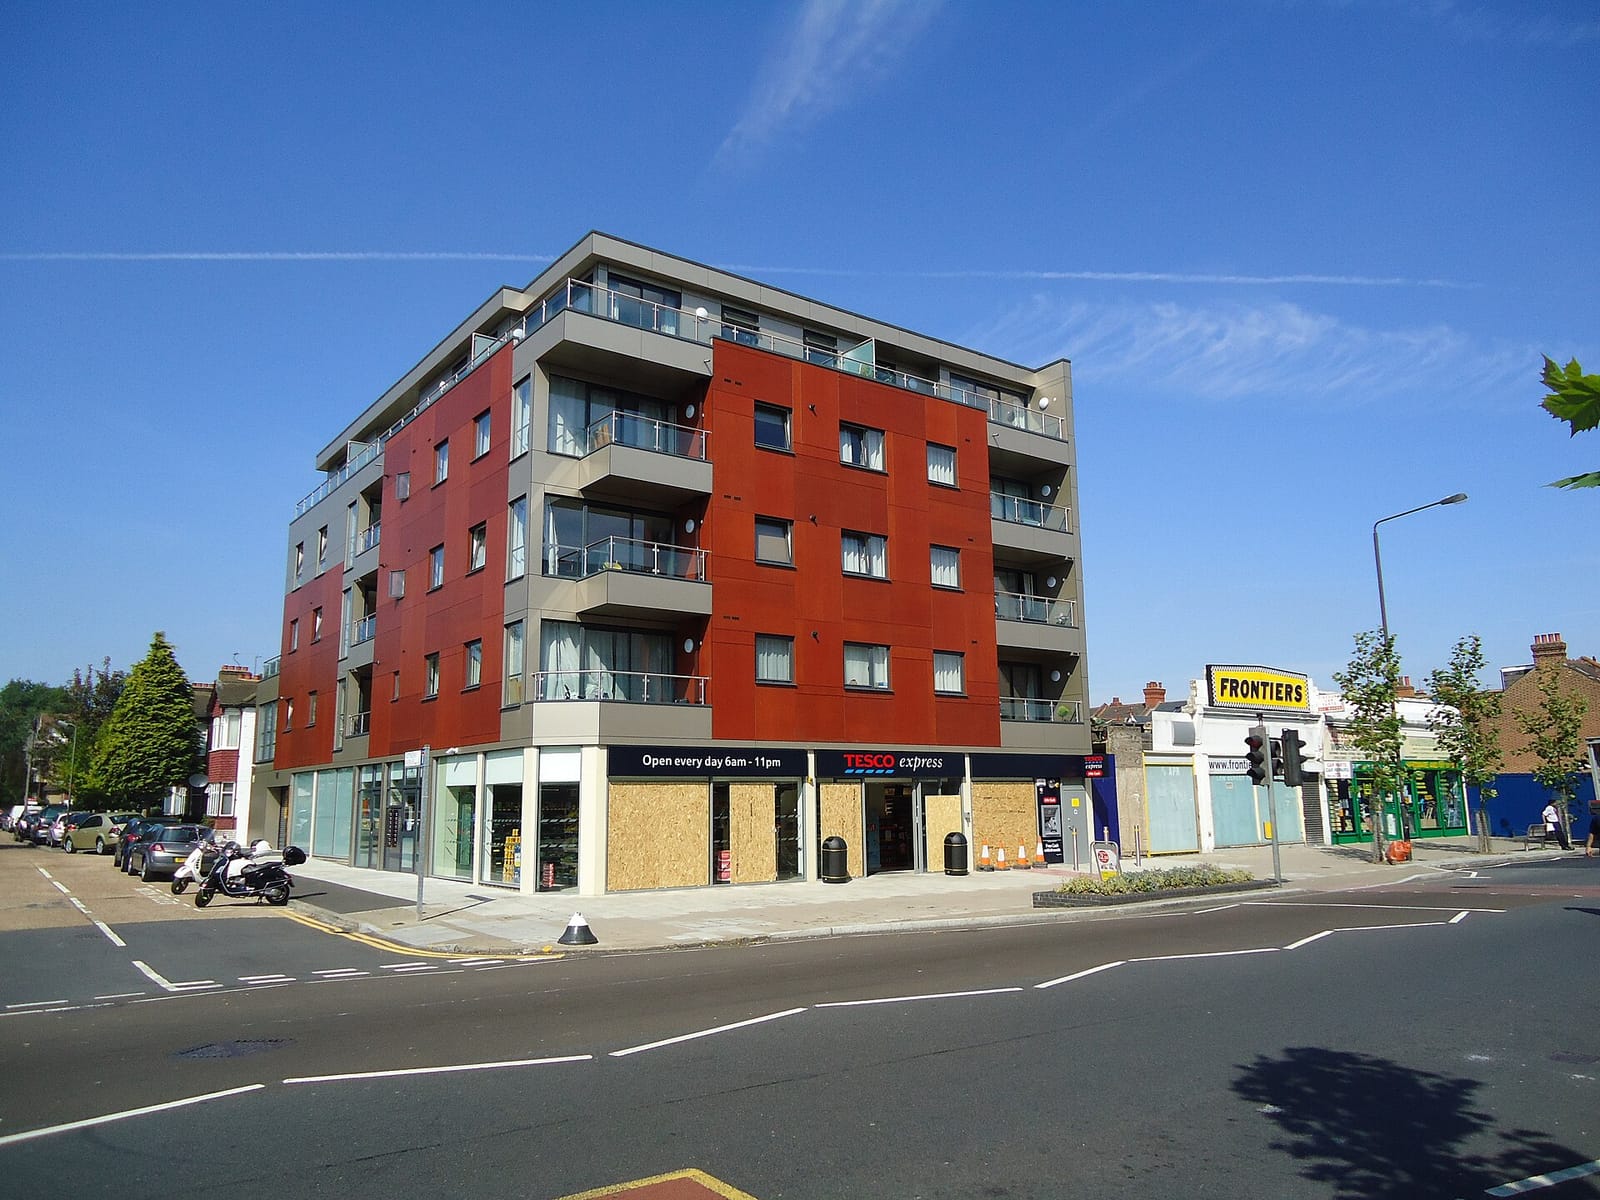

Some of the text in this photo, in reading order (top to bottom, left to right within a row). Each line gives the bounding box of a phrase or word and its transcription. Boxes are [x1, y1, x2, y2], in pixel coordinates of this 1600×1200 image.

[1220, 678, 1303, 703] FRONTIERS
[642, 754, 673, 769] Open
[674, 757, 702, 769] every
[704, 756, 723, 769] day
[725, 756, 747, 767] 6am
[754, 756, 781, 769] 11pm
[843, 753, 943, 772] TESCO express
